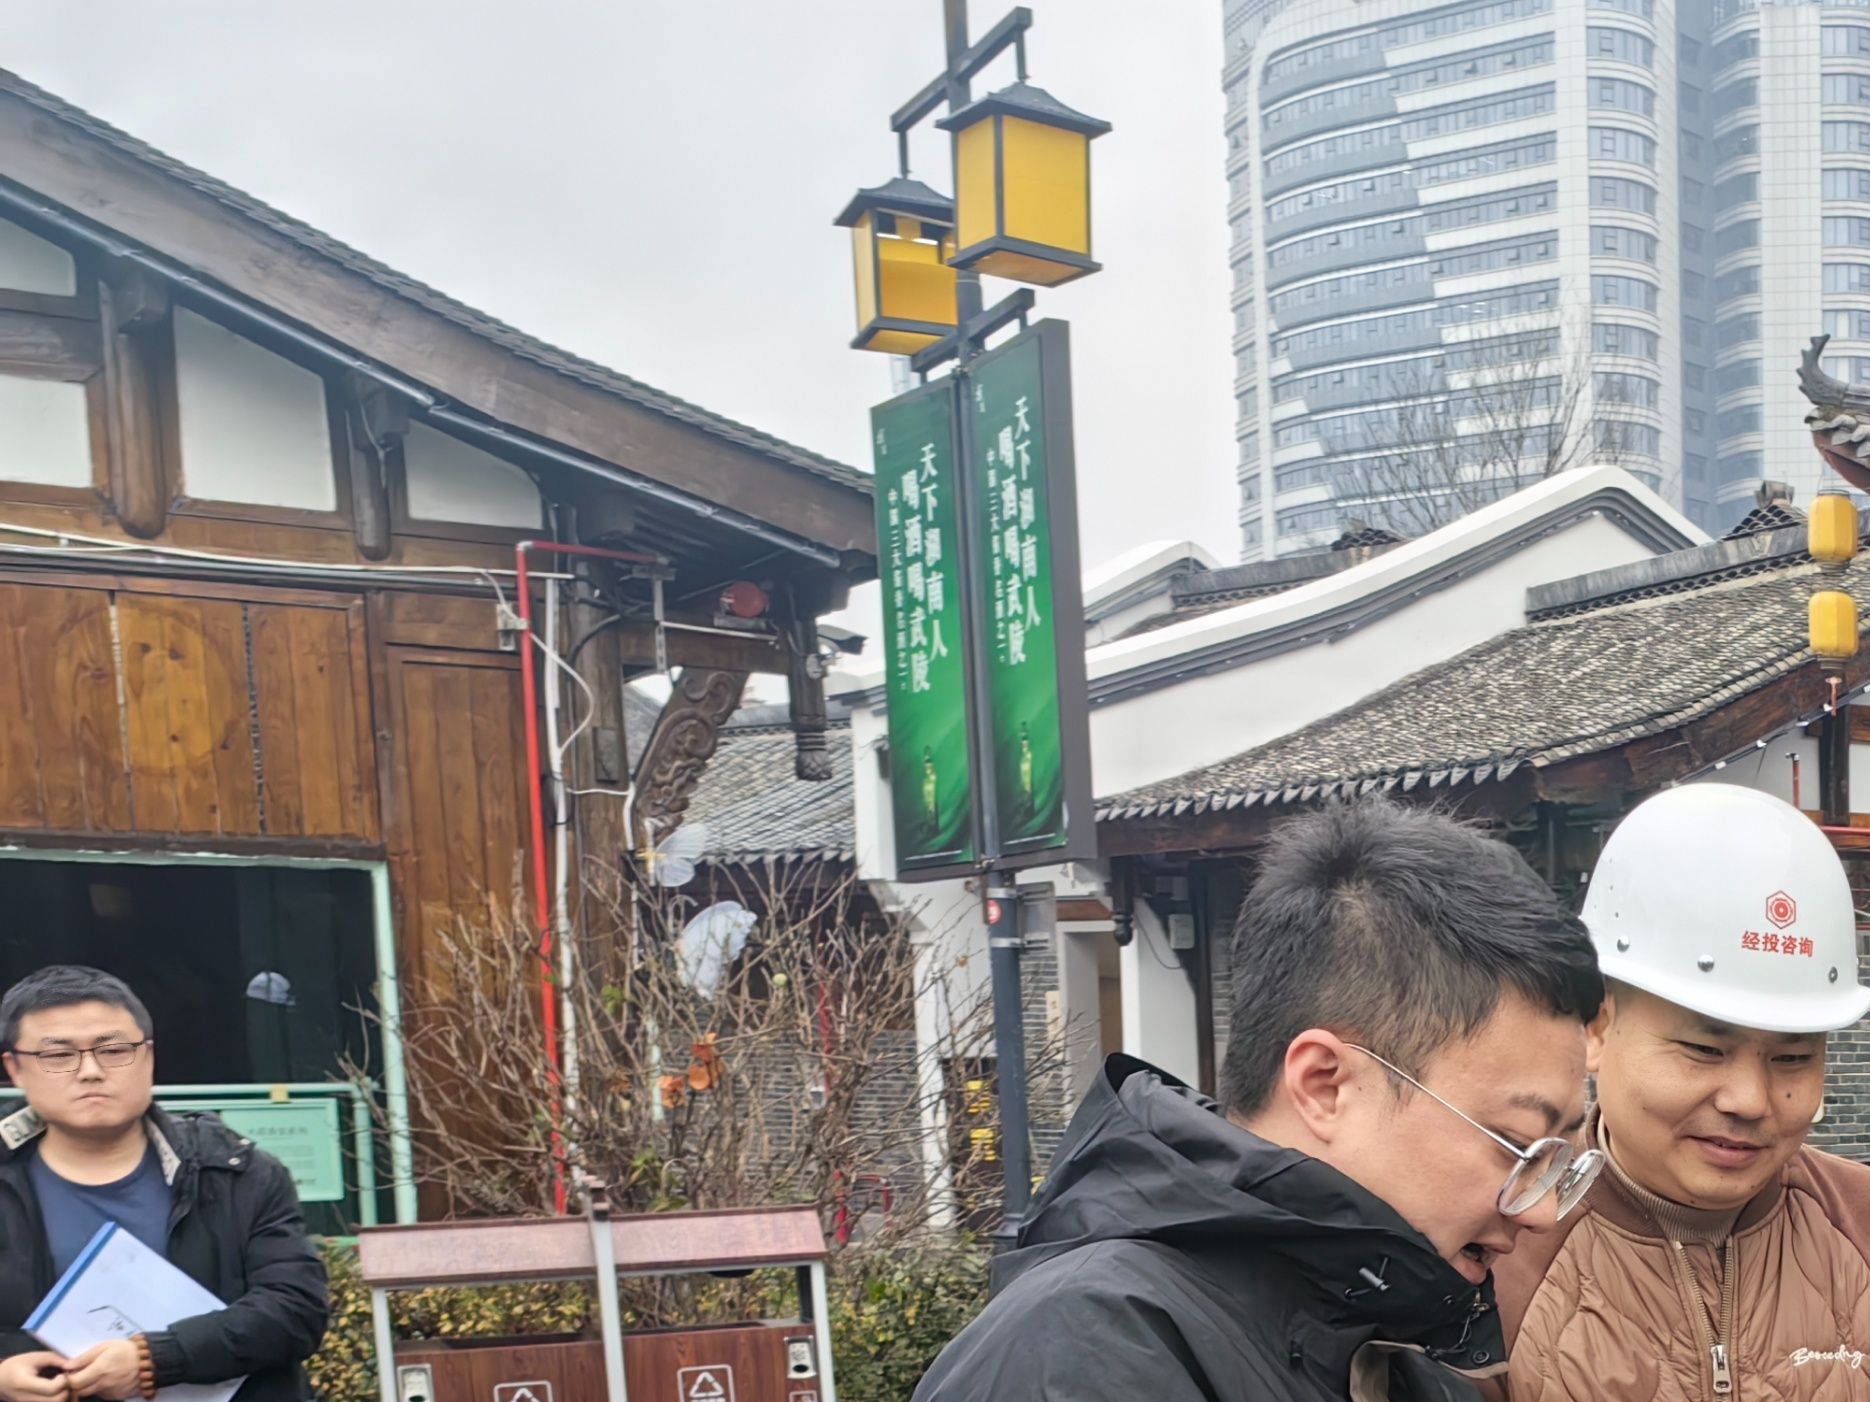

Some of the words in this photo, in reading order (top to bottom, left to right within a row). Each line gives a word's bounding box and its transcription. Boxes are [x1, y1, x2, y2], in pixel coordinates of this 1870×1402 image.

[901, 469, 931, 693] 喝酒喝武陵
[919, 443, 948, 661] 天下湖南人
[998, 425, 1026, 665] 喝酒喝武陵
[1014, 396, 1041, 631] 天下湖南人
[1741, 930, 1814, 958] 经投咨询
